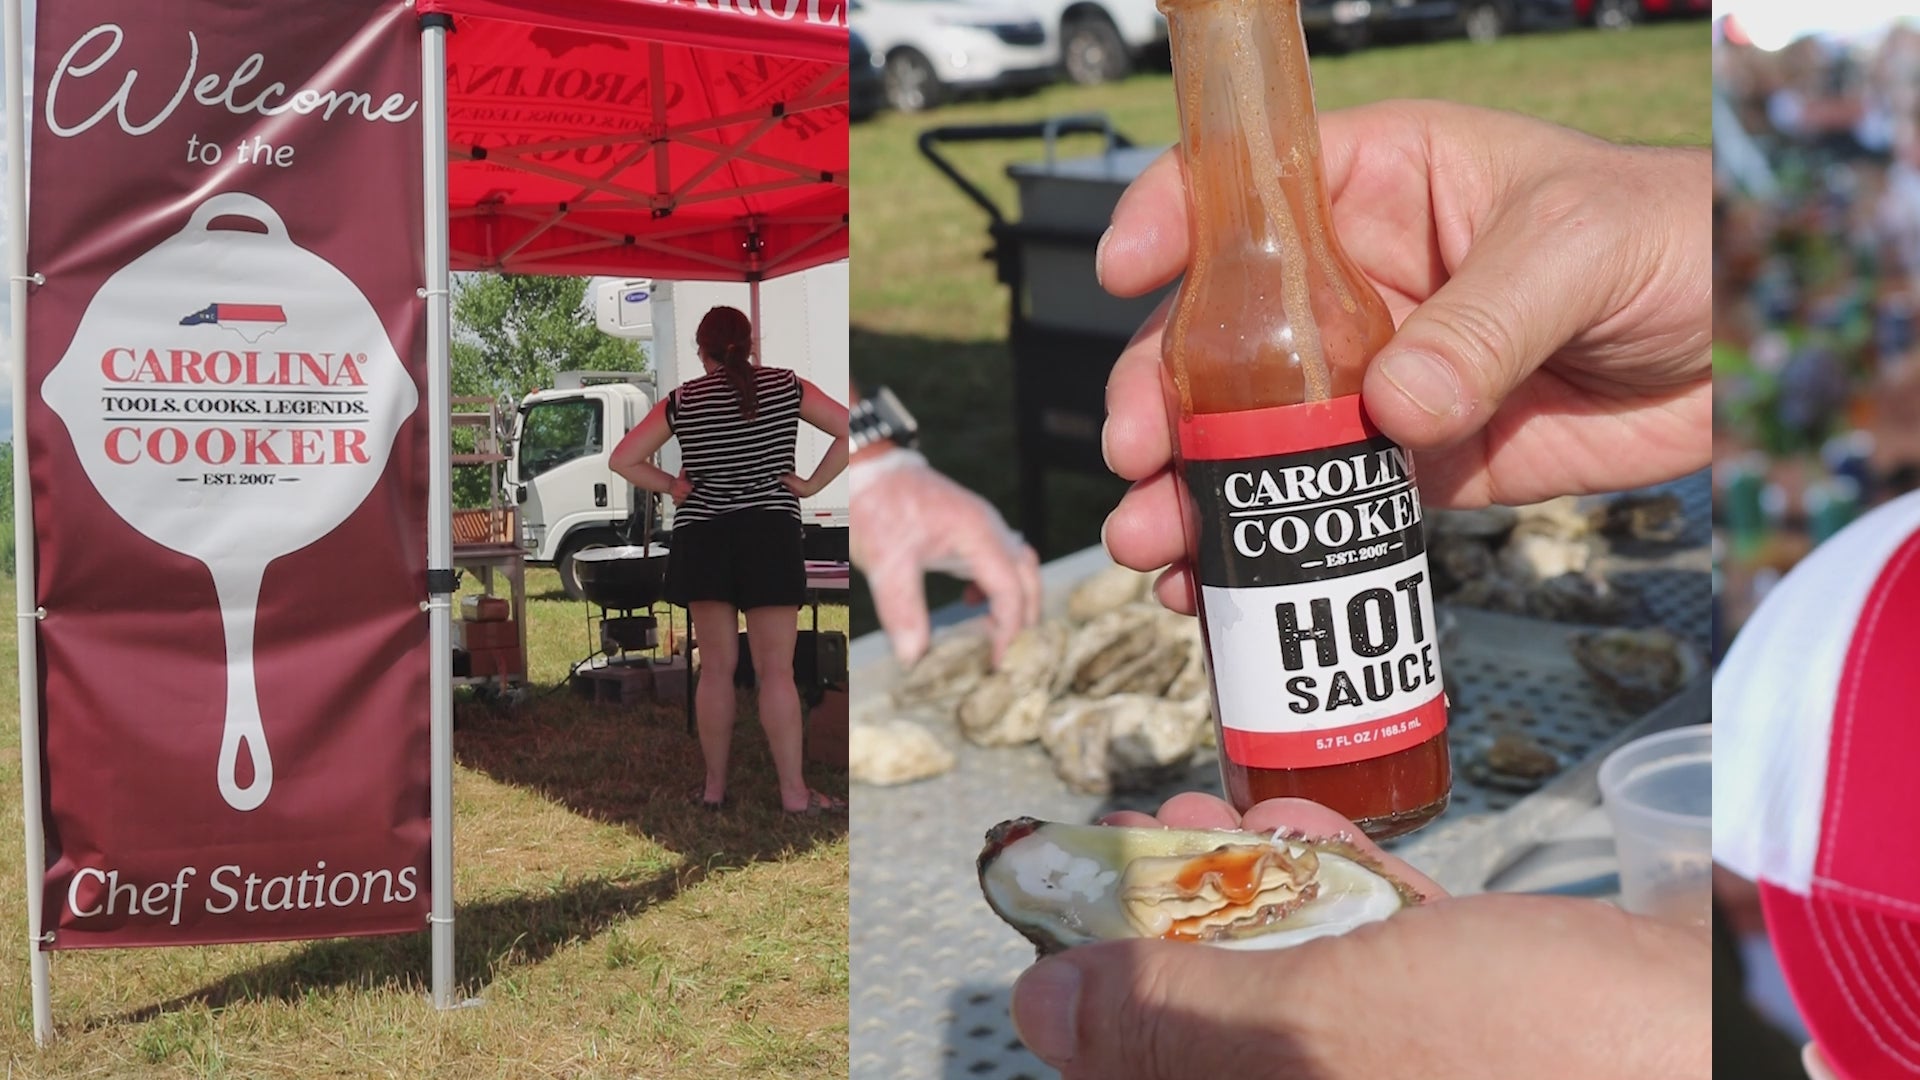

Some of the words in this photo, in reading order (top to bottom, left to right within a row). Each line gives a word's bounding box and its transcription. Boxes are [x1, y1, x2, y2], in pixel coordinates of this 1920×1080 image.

[46, 24, 419, 138] Welcome
[187, 134, 222, 163] to
[237, 136, 295, 167] the
[101, 397, 180, 413] TOOLS.
[184, 399, 261, 414] COOKS.
[265, 400, 370, 415] LEGENDS.
[103, 426, 371, 466] COOKER
[202, 473, 237, 486] EST.
[239, 473, 276, 486] 2007
[1325, 550, 1361, 569] EST.
[1360, 542, 1389, 562] 2007
[1275, 571, 1424, 671] HOT
[1286, 644, 1436, 715] SAUCE
[1316, 737, 1333, 750] 5.7
[1336, 734, 1352, 747] FL
[1353, 730, 1371, 744] OZ
[1408, 717, 1421, 731] mL
[67, 866, 197, 926] Chef
[204, 860, 418, 915] Stations
